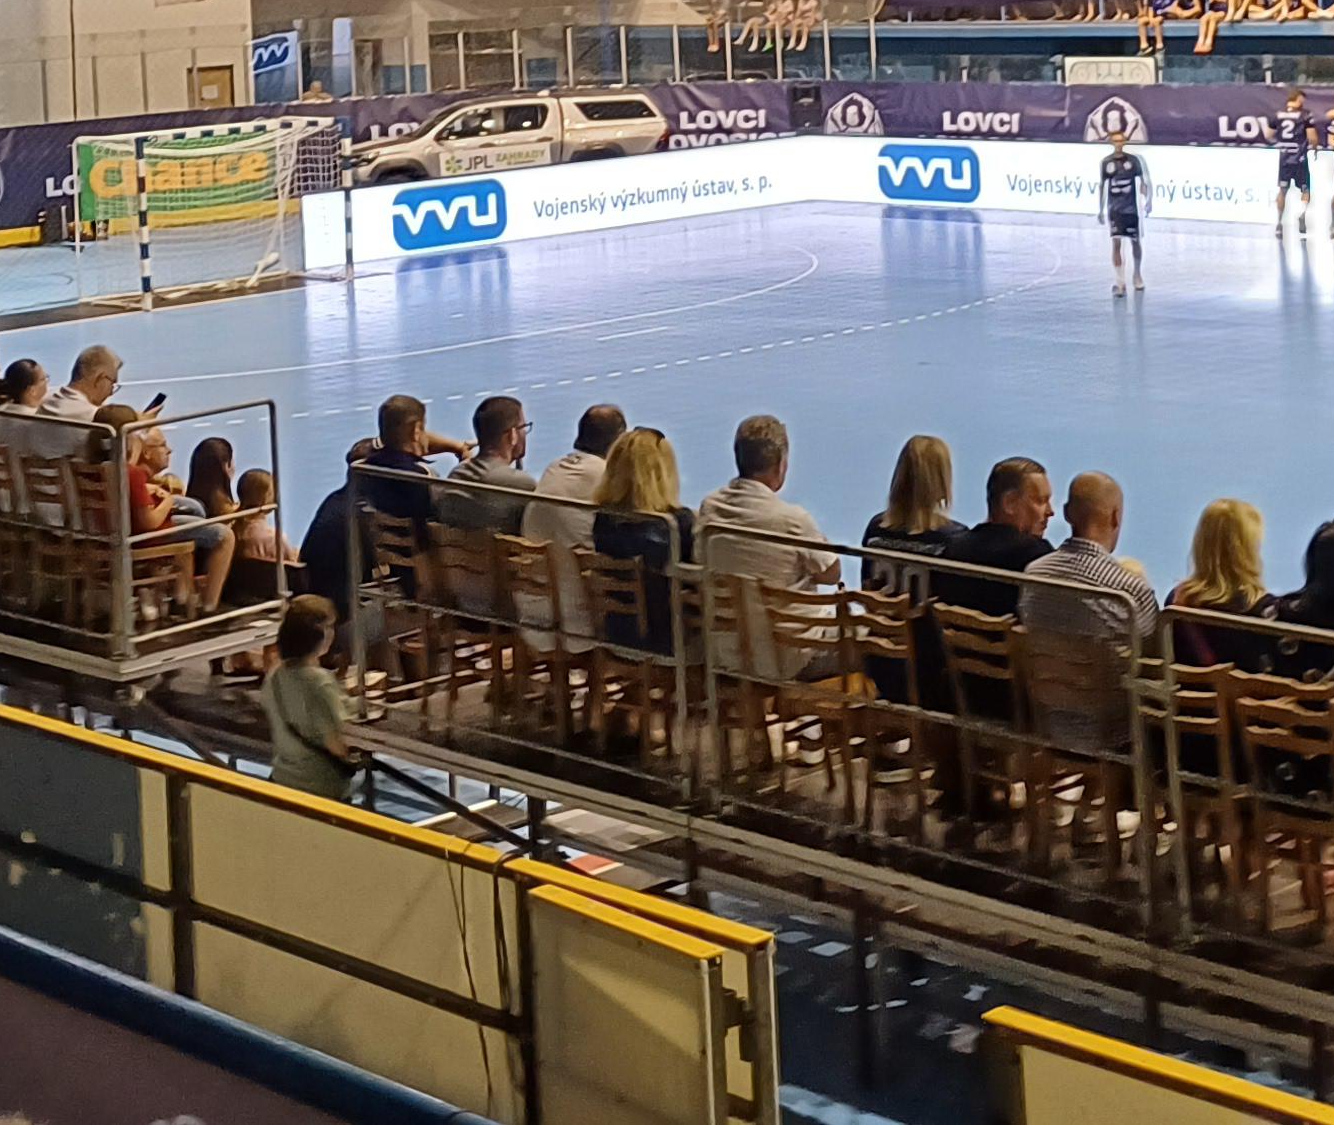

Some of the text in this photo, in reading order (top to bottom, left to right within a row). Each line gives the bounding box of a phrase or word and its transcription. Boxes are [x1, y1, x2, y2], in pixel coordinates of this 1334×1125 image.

[679, 108, 766, 130] LOVCI
[942, 110, 1021, 134] LOVCI
[1281, 120, 1296, 139] 2
[464, 155, 493, 171] JPL
[534, 172, 773, 219] Vojenský výzkumný ústav, s. p.
[1007, 173, 1083, 200] Vojenský
[1182, 179, 1238, 205] ústav,
